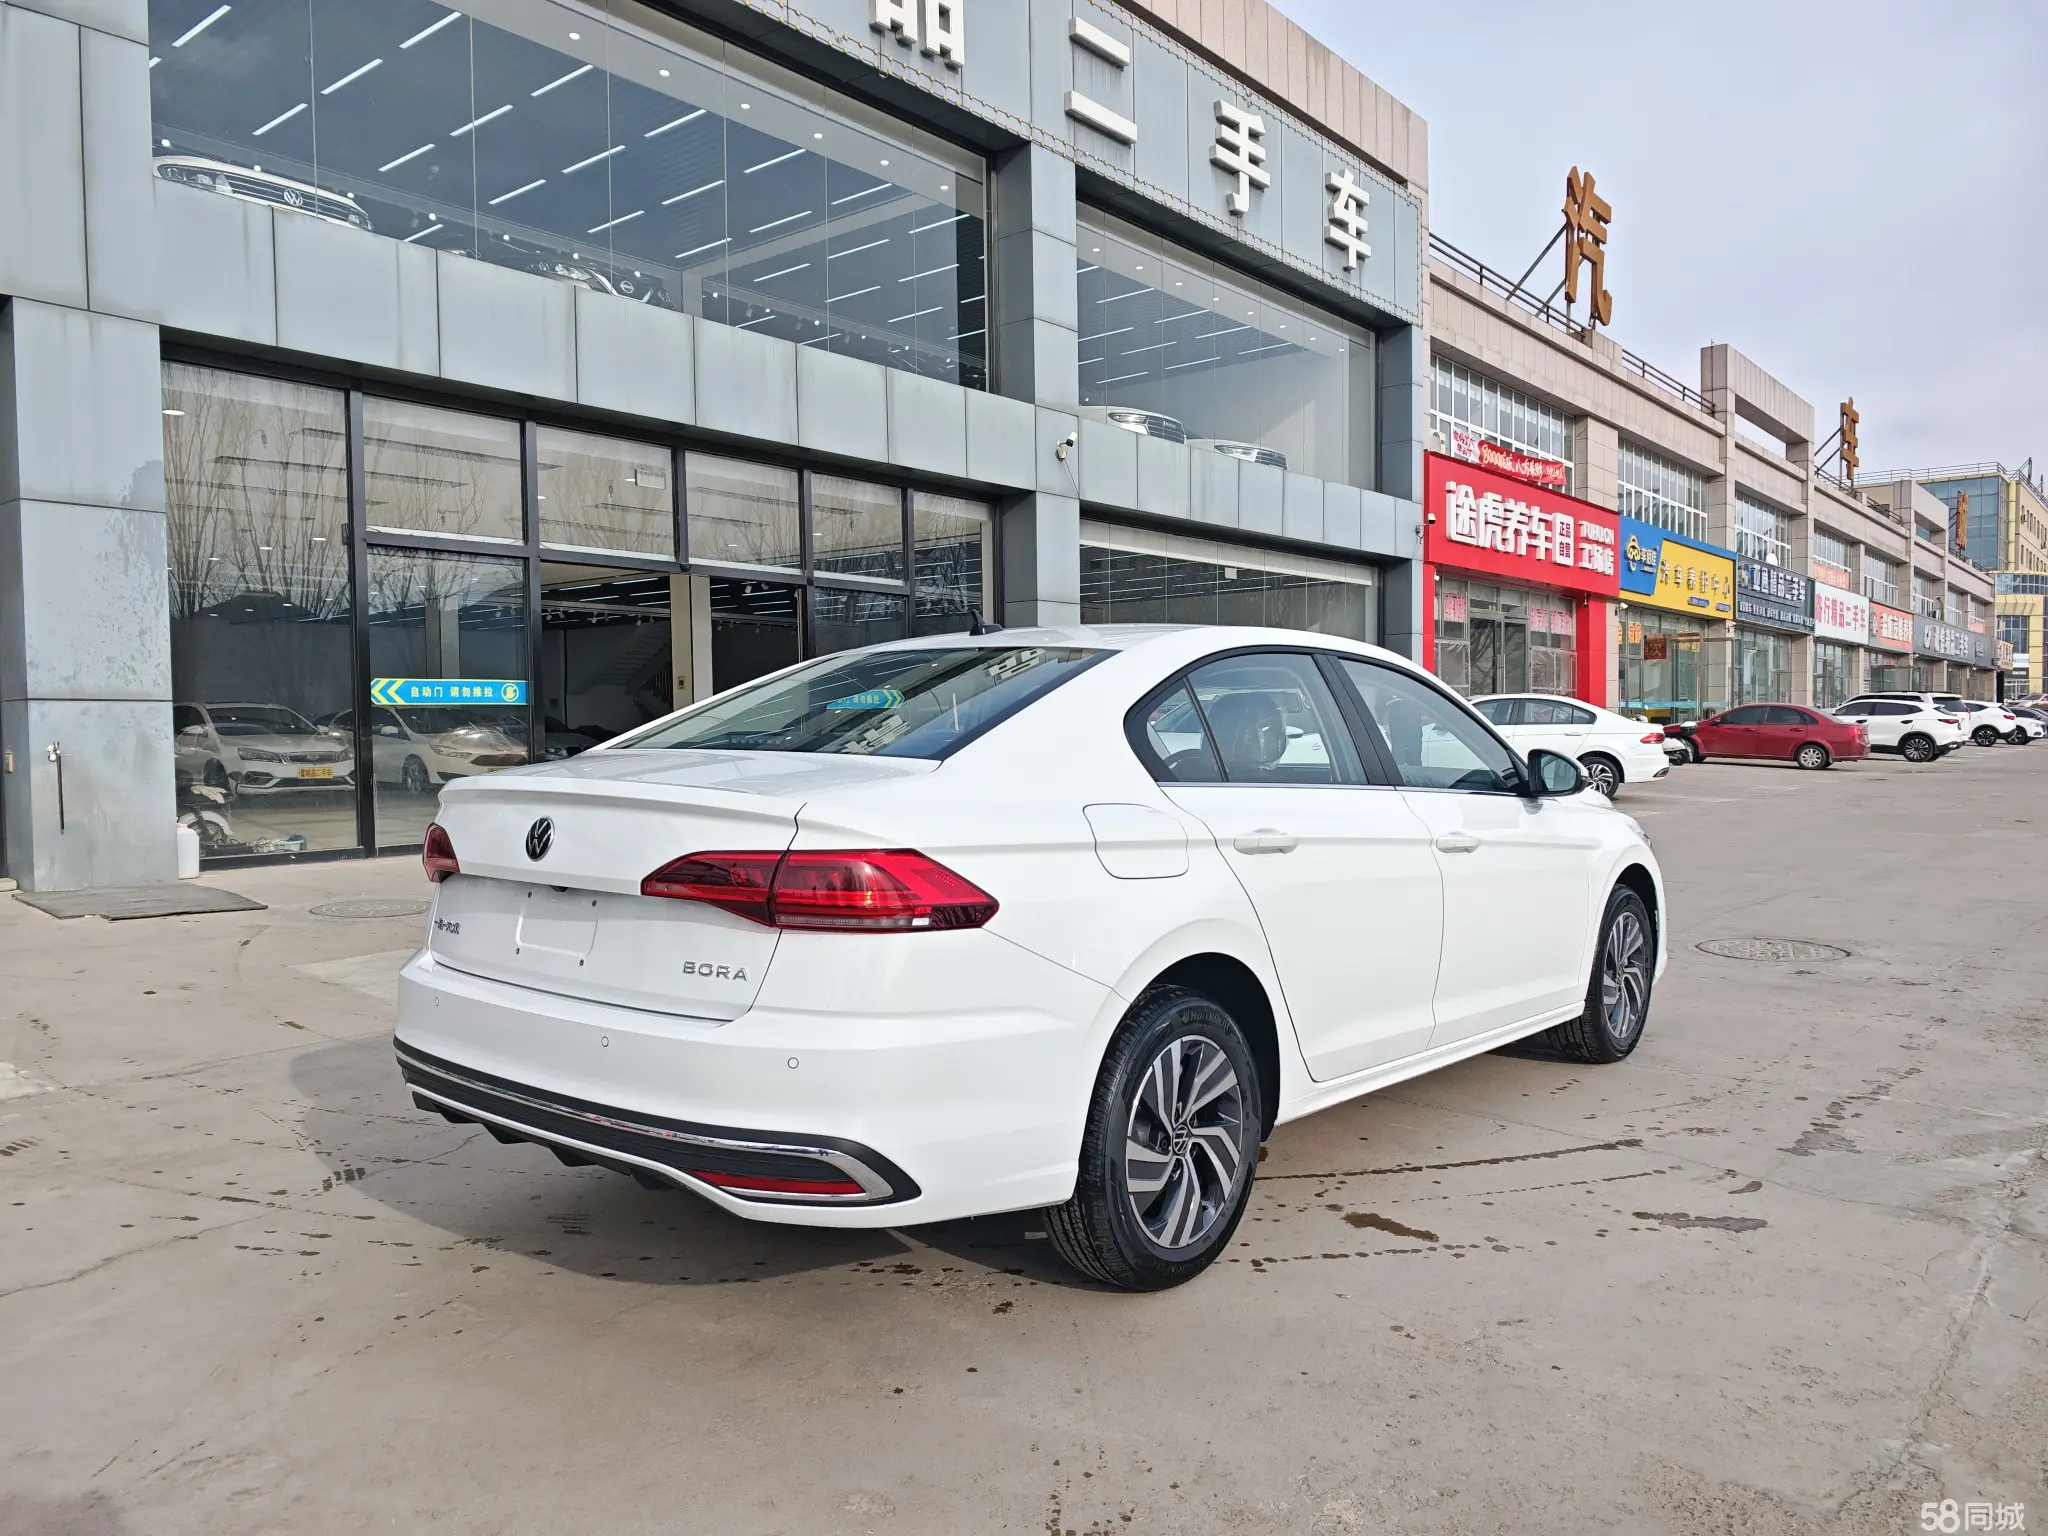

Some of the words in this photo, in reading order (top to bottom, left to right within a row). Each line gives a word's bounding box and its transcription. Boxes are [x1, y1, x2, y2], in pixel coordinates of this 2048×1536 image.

[1564, 166, 1612, 326] 汽
[1840, 396, 1859, 480] 车
[1446, 481, 1553, 560] 途虎养车
[1579, 542, 1614, 576] 工场店
[1660, 559, 1730, 600] 汽车养护中心
[410, 685, 443, 698] 自动门
[450, 685, 494, 698] 请勿推拉
[683, 960, 748, 981] BORA
